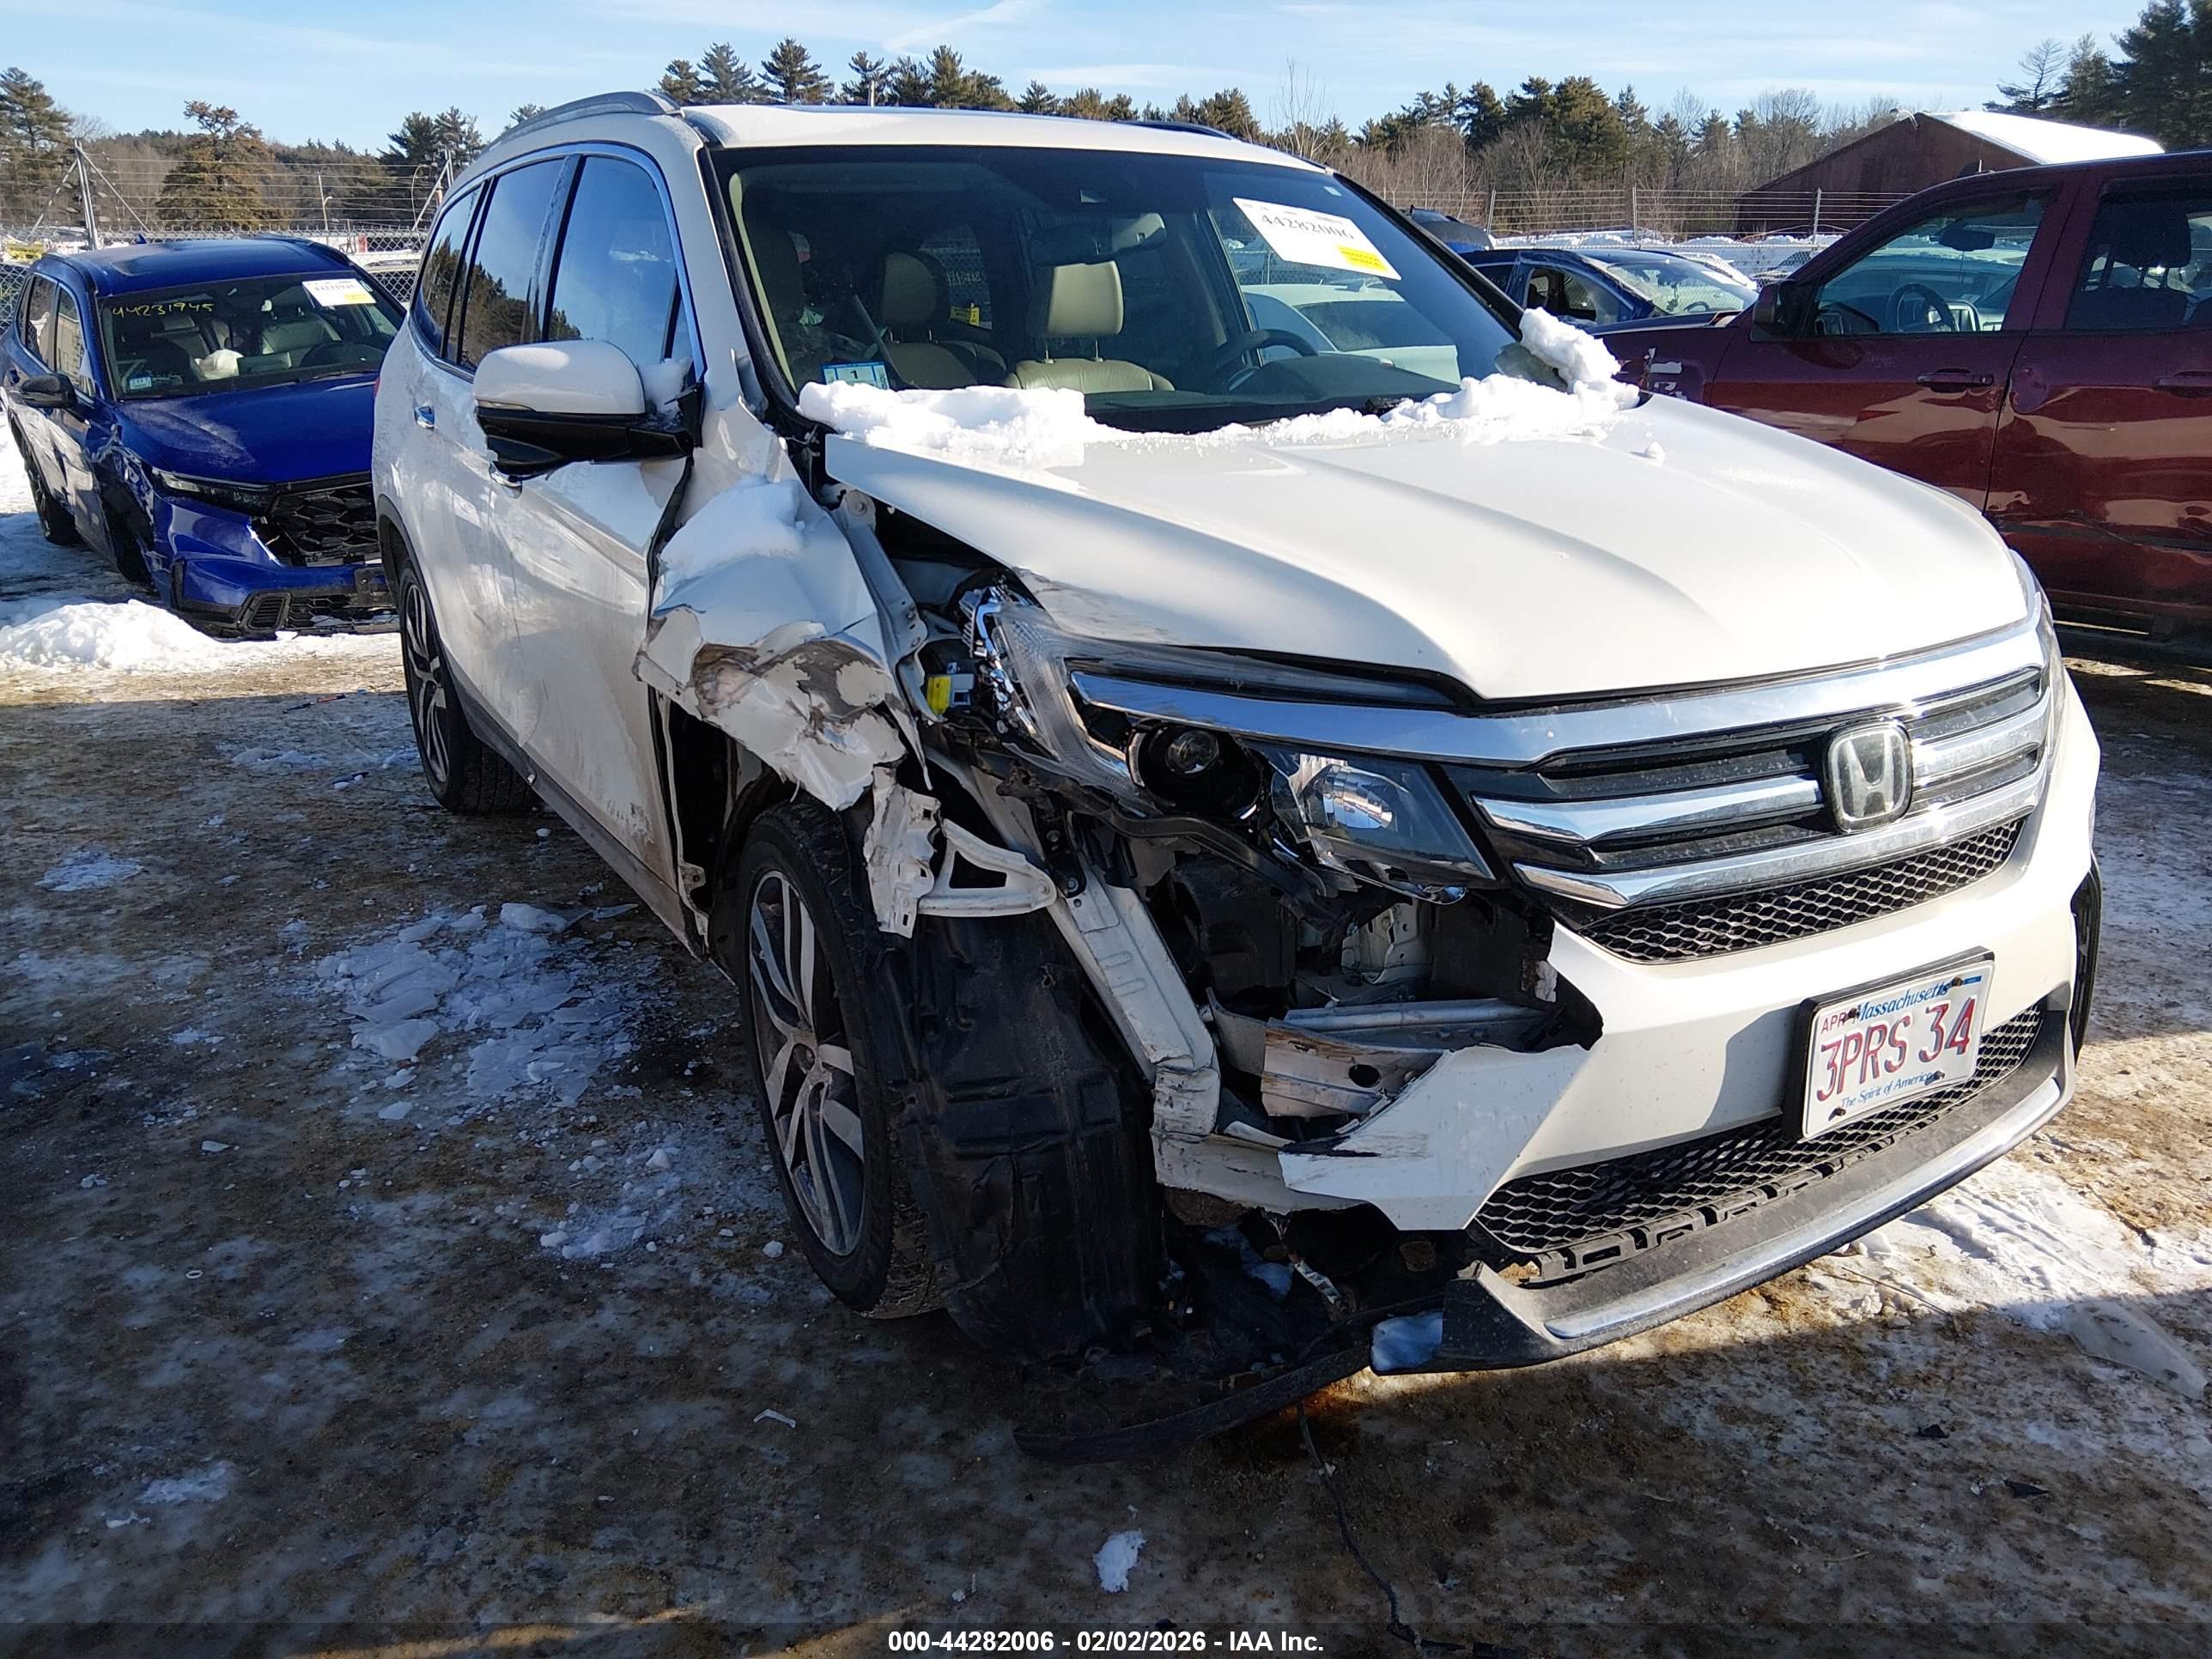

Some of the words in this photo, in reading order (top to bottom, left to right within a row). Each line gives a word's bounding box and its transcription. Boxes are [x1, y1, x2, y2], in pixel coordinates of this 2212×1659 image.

[1261, 215, 1355, 240] 44282006
[112, 301, 214, 319] 44231945
[1820, 1012, 1847, 1035] APR
[1816, 1014, 1911, 1102] 3PRS
[1917, 996, 1977, 1063] 34
[1841, 1096, 1856, 1109] The
[1857, 1085, 1882, 1104] Spirit
[1883, 1079, 1893, 1096] of
